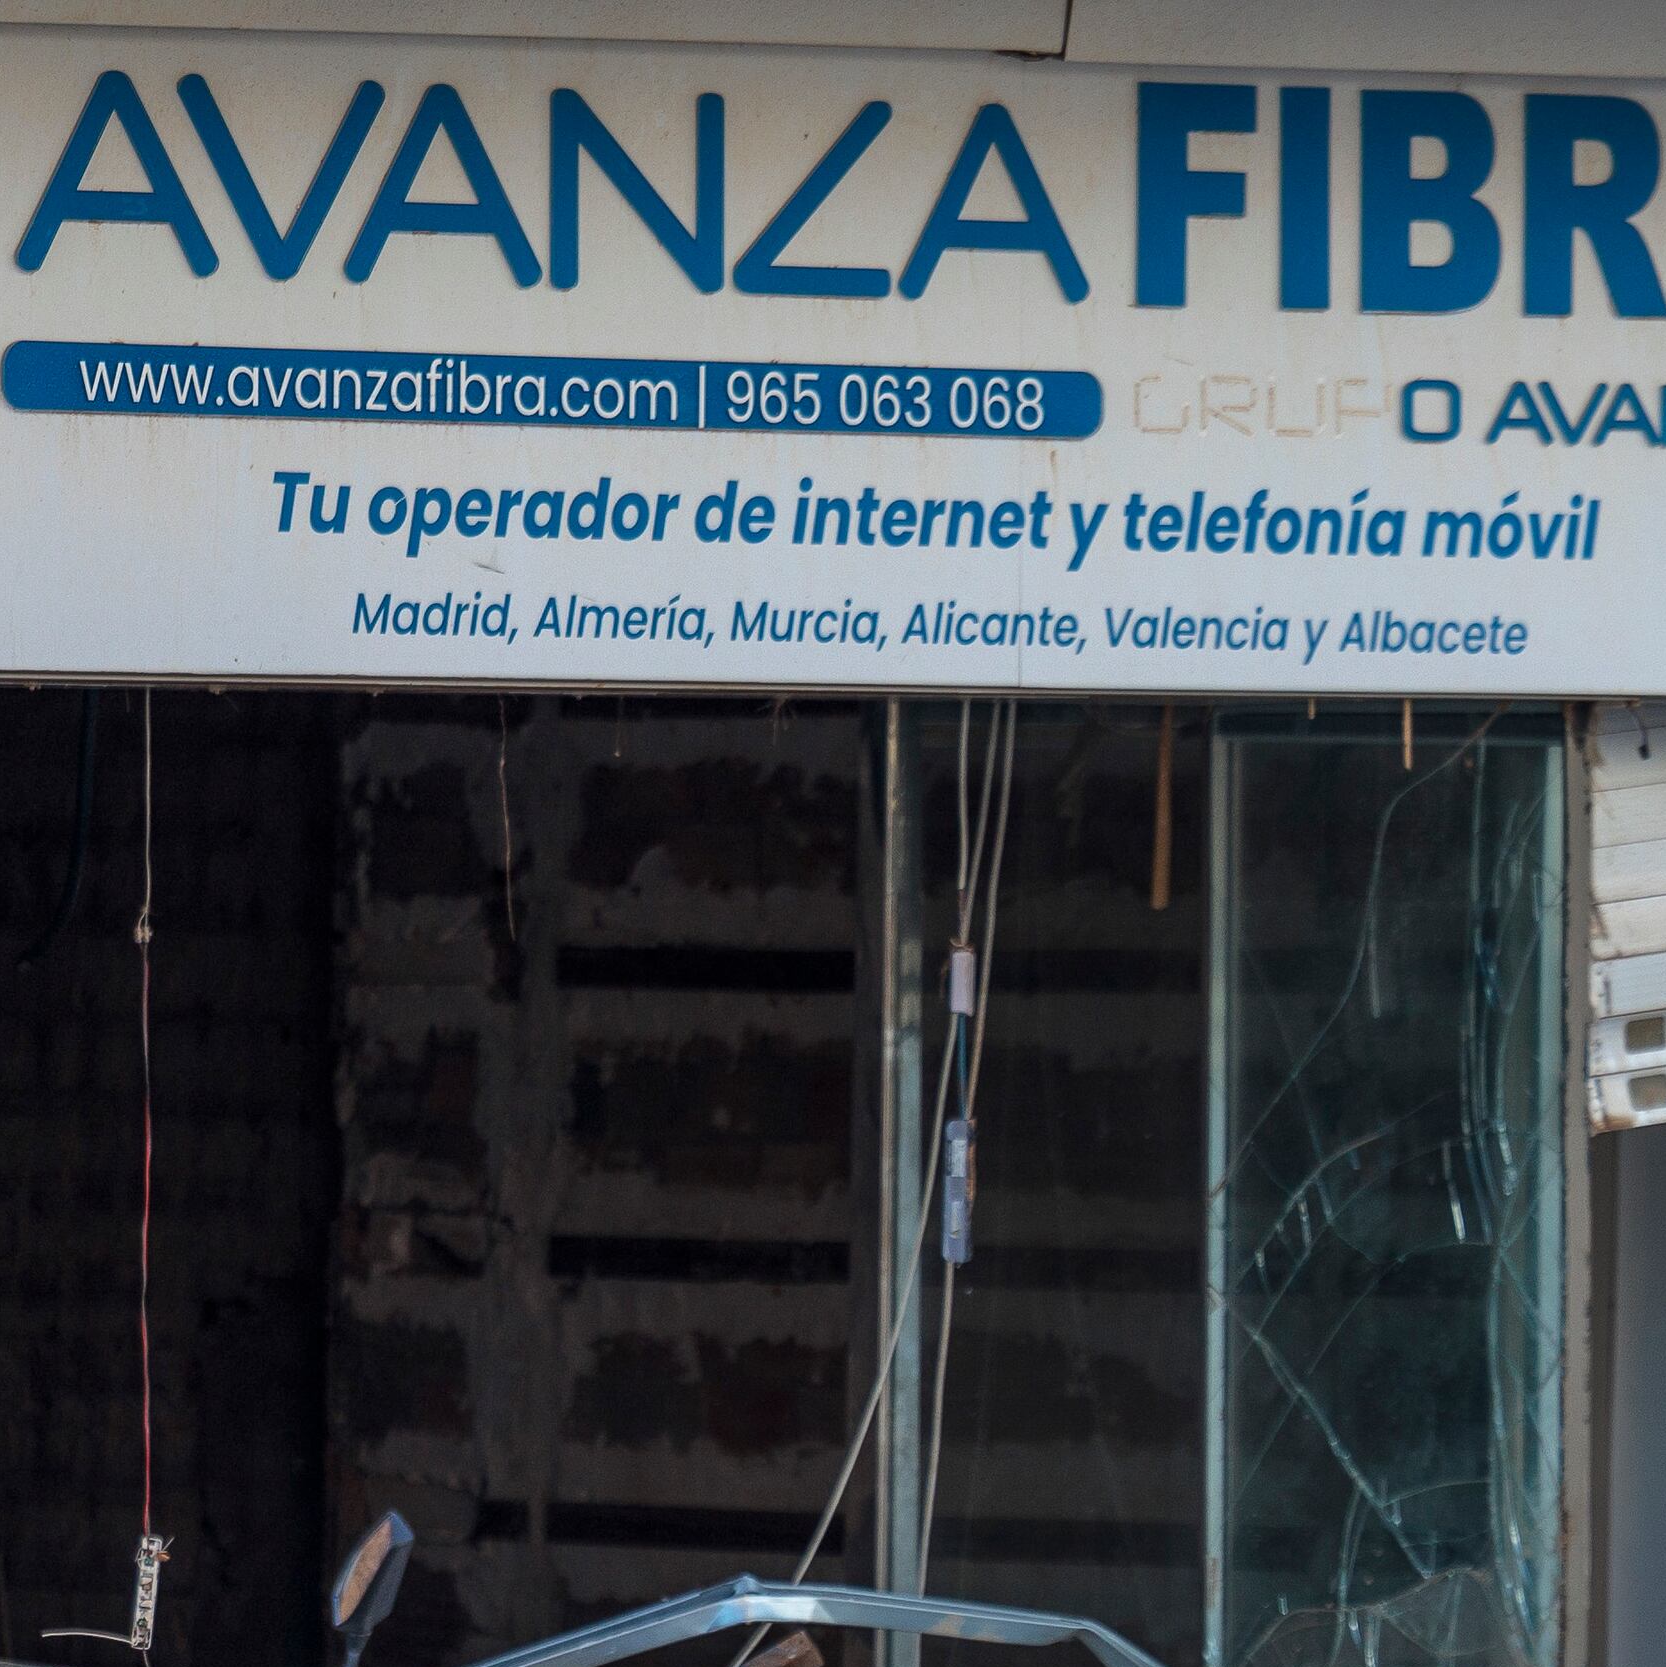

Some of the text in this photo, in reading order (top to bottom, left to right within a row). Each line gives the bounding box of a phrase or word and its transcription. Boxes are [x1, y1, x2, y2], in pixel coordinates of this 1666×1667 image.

[17, 73, 1089, 303] AVANZA
[79, 358, 678, 421] www.avanzafibra.com
[727, 370, 821, 425] 965
[839, 373, 931, 428] 063
[950, 376, 1044, 431] 068
[273, 471, 1600, 572] Tu operador de internet y telefonía móvil
[352, 591, 1528, 662] Madrid, Almería, Murcia, Alicante, Valencia y Albacete
